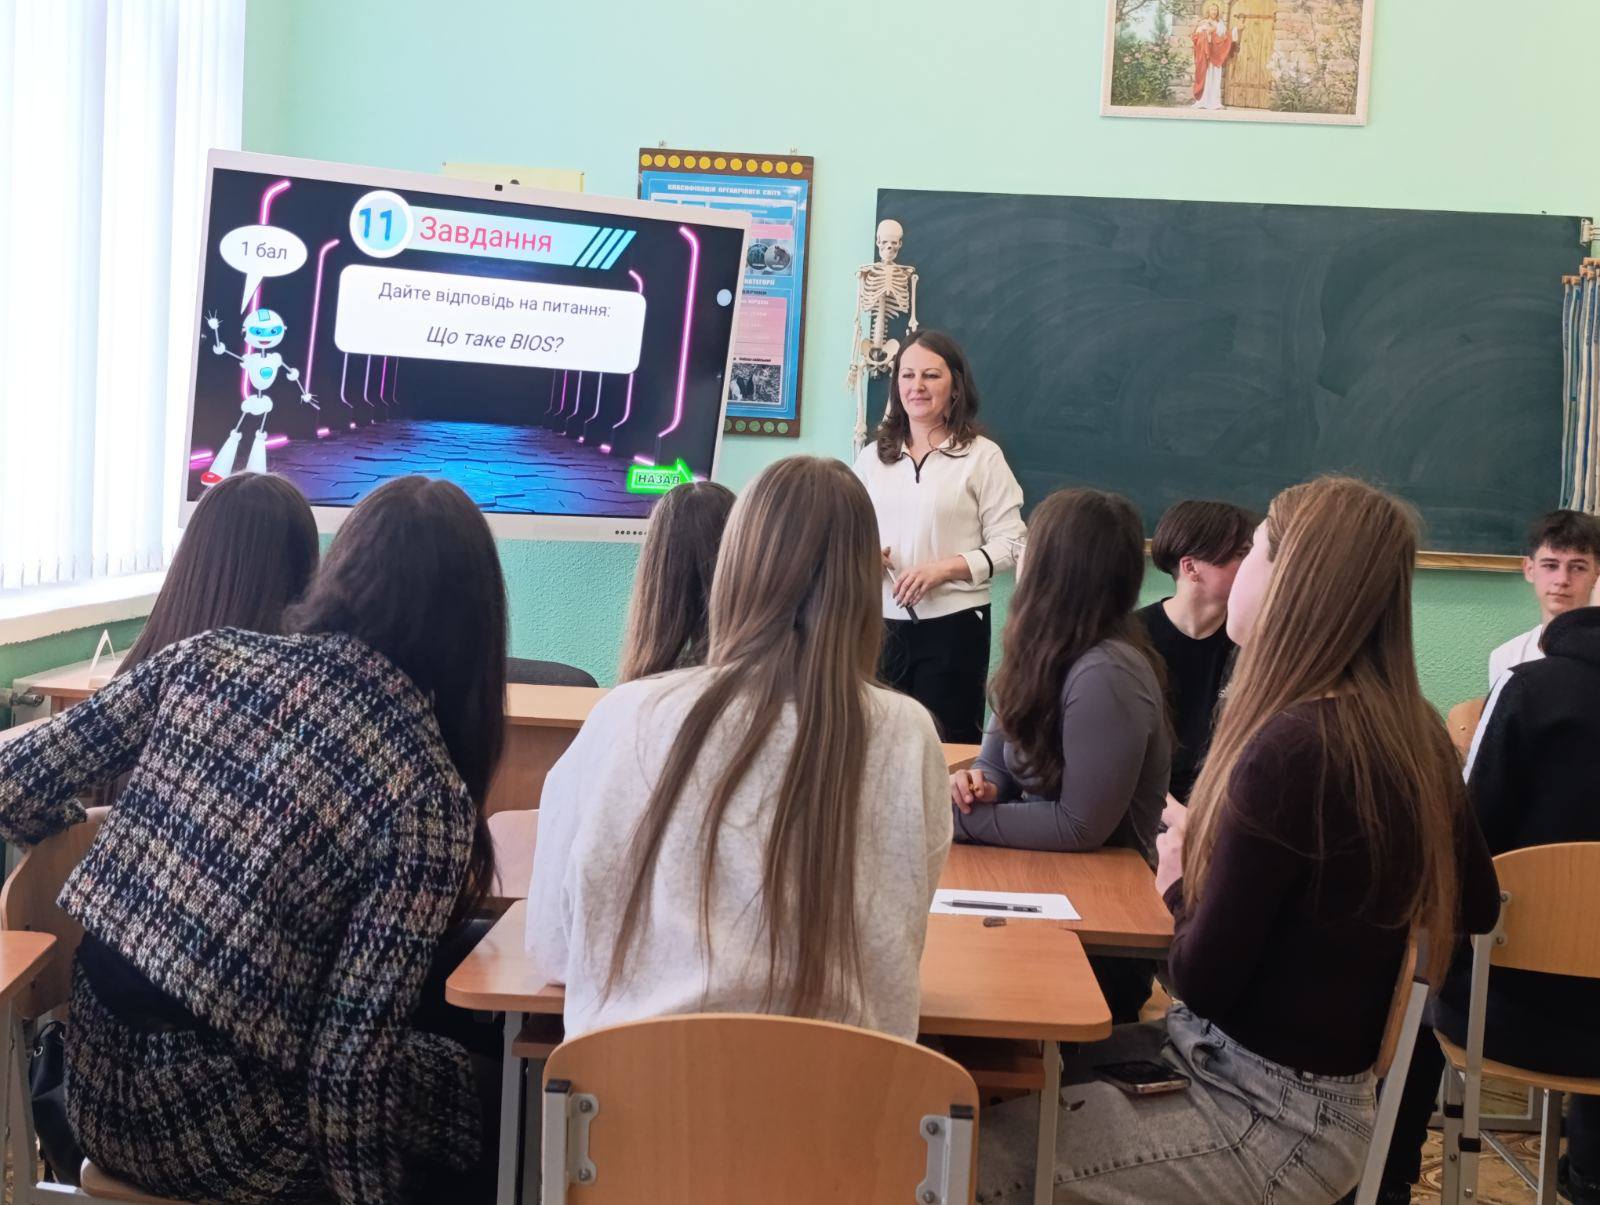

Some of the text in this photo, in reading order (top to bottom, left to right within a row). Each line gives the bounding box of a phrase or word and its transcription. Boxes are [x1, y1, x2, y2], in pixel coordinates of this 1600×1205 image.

[358, 207, 392, 242] 11
[419, 215, 553, 254] Завдання
[241, 241, 287, 260] 1 бал
[378, 282, 611, 318] Дайте відповідь на питання:
[426, 325, 565, 353] Що таке BIOS?
[637, 473, 681, 485] НАЗАД
